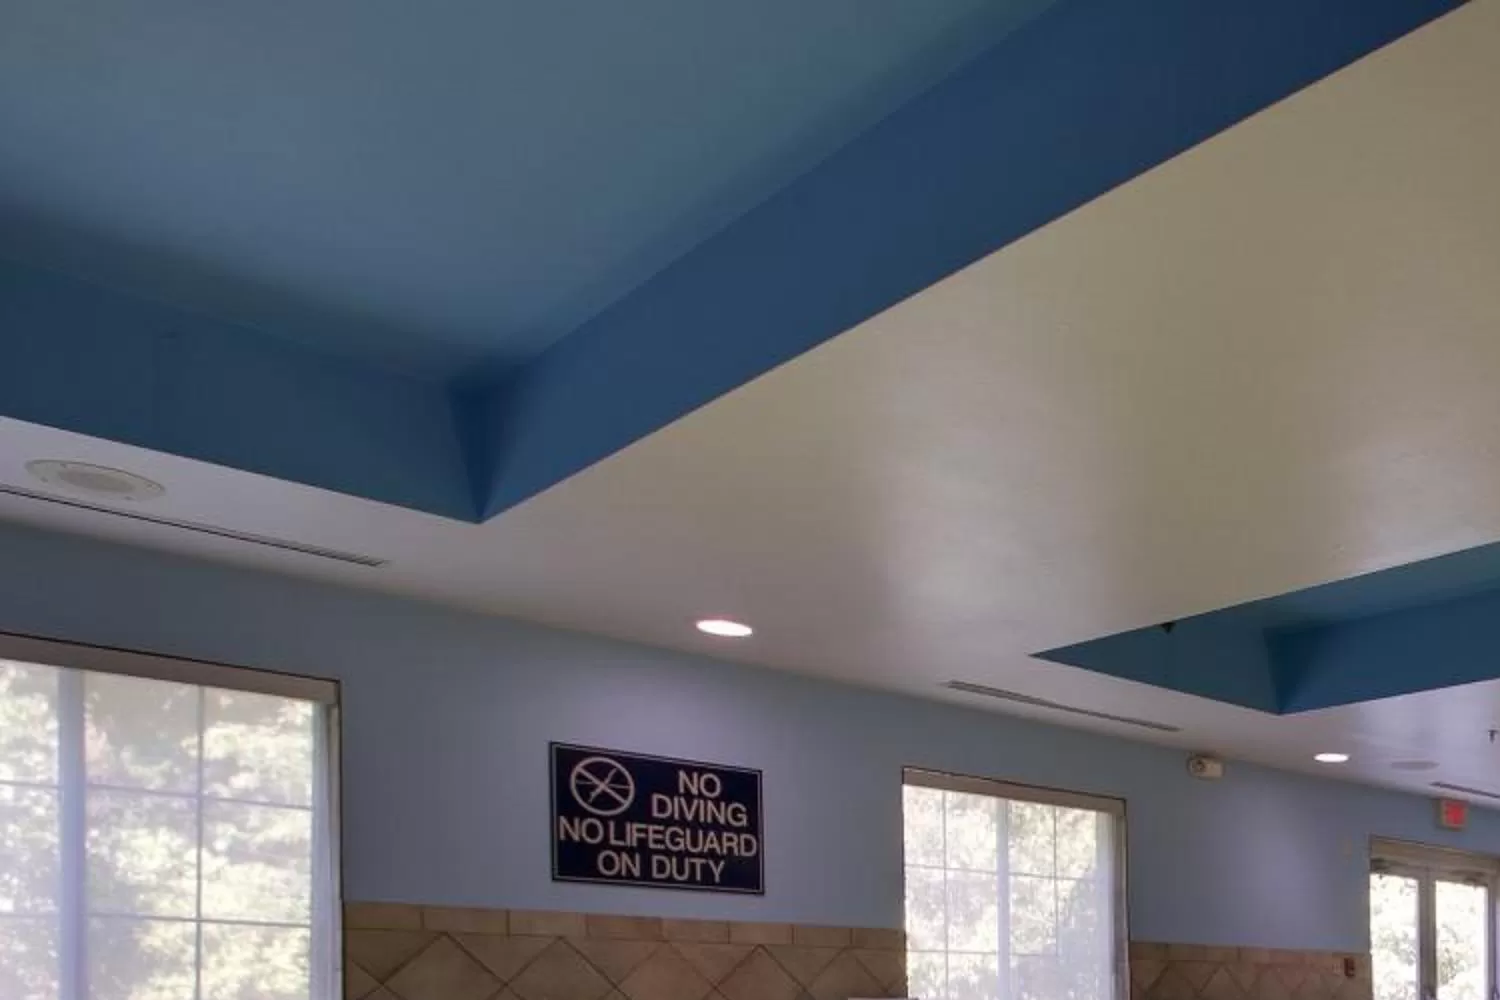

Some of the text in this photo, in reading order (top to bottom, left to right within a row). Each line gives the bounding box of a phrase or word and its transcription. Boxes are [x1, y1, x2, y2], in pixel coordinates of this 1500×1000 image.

[679, 769, 722, 798] NO
[652, 793, 748, 827] DIVING
[559, 816, 757, 857] NO LIFEGUARD
[597, 850, 725, 883] ON DUTY
